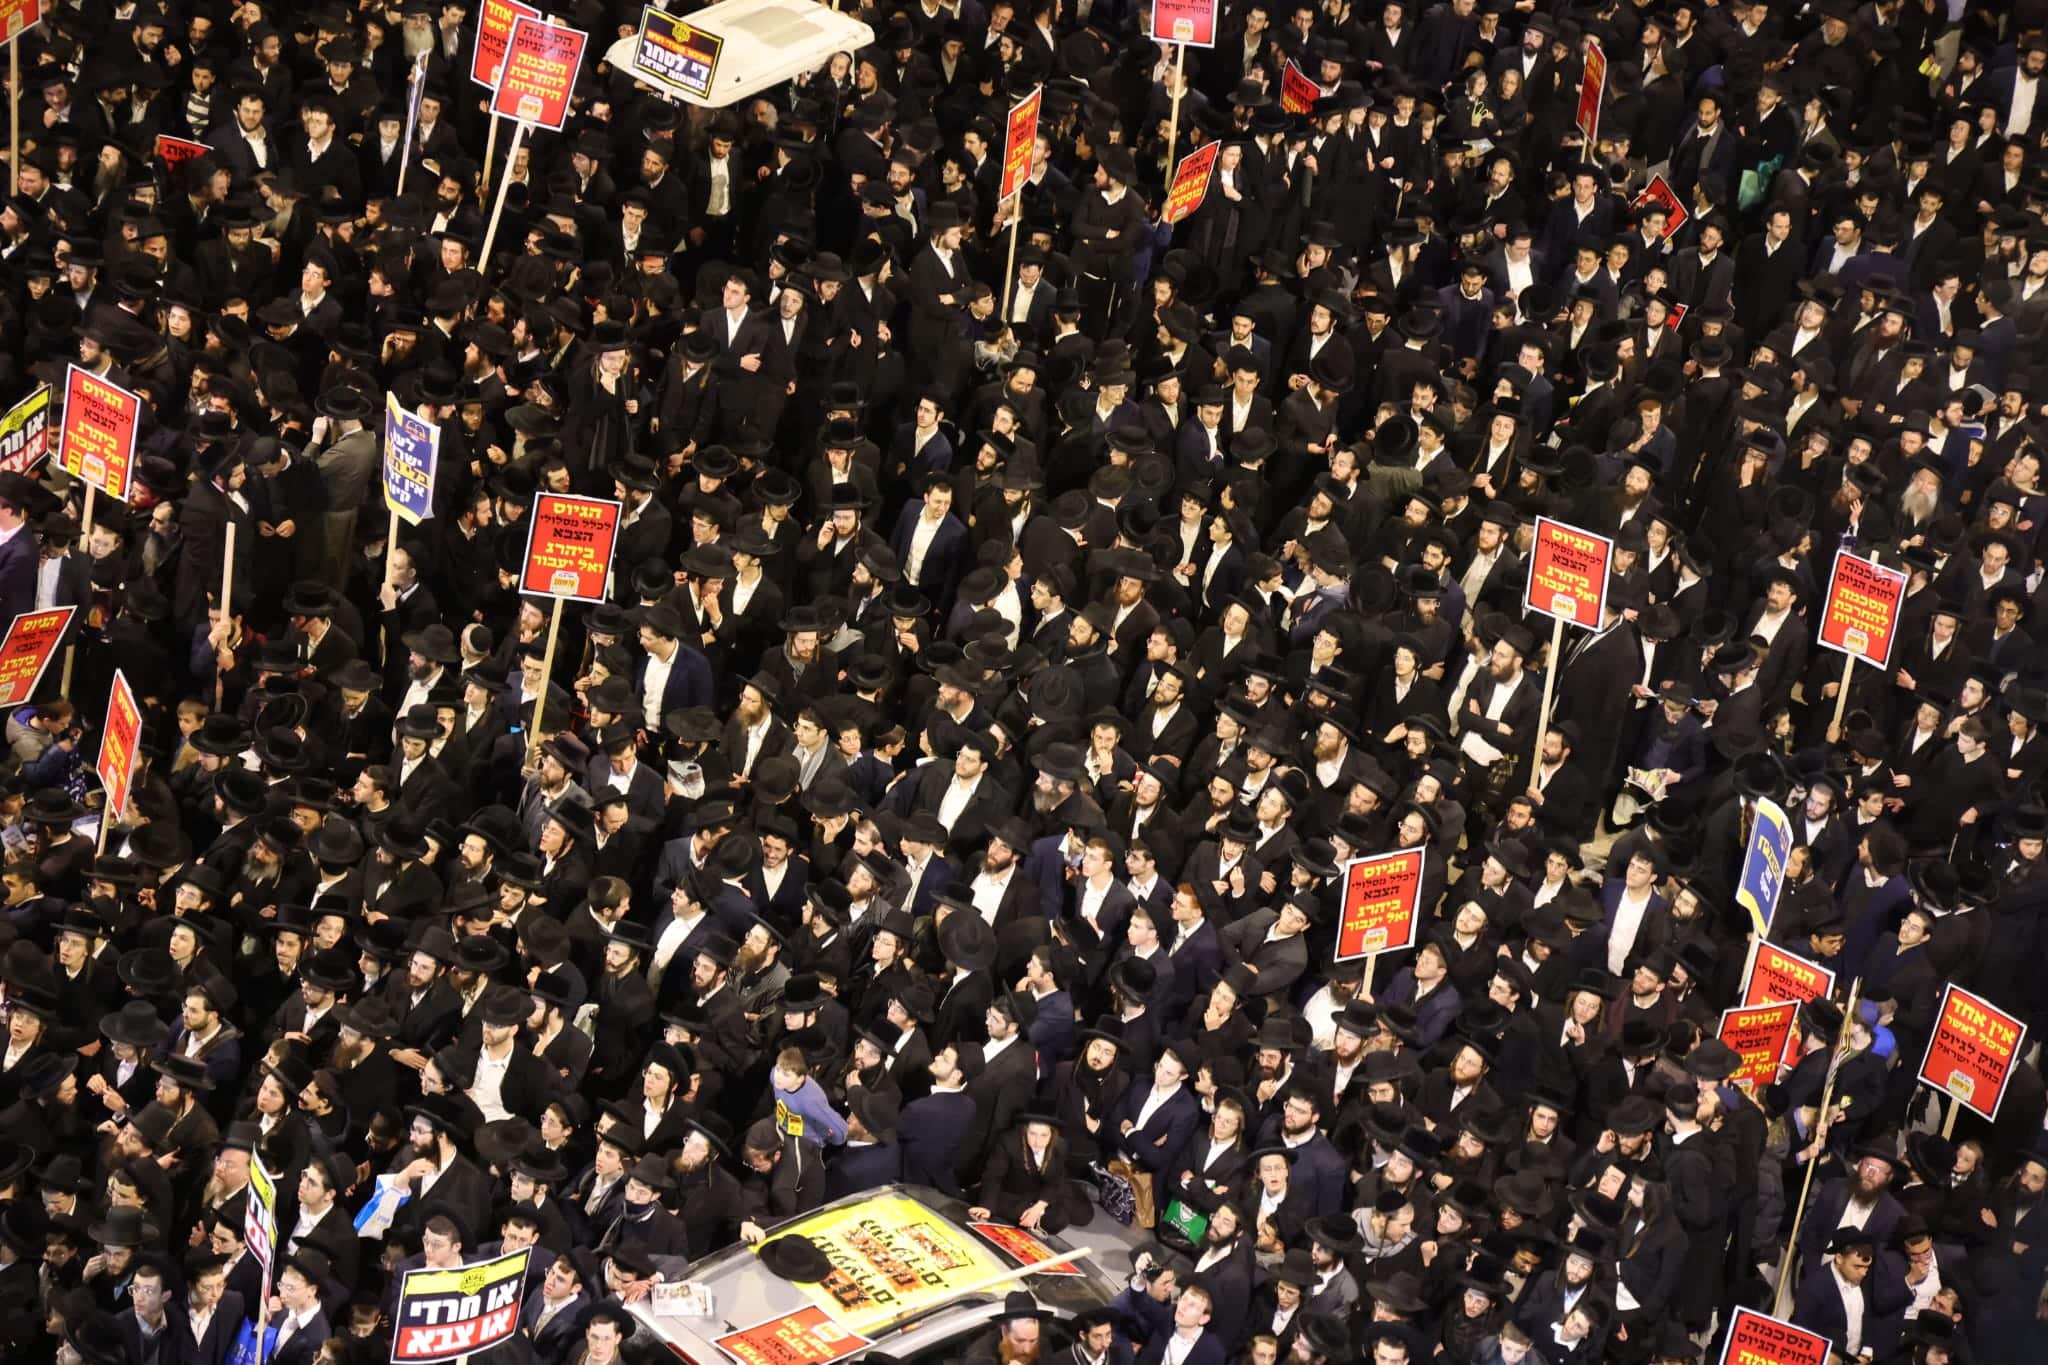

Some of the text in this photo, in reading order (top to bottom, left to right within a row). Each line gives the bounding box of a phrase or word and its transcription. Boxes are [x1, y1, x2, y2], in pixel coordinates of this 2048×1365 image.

[516, 52, 568, 75] הסכמה
[644, 40, 710, 82] די לסחר
[510, 65, 567, 88] להחרבת
[508, 78, 562, 101] היהדות
[82, 380, 123, 409] הגיוס
[84, 407, 117, 432] הצבא
[68, 430, 100, 453] יעבור
[77, 421, 118, 450] ביהרג
[104, 447, 125, 468] ואל
[553, 502, 602, 519] הגיוס
[540, 514, 611, 531] לכלל מסלולי
[553, 527, 594, 542] הצבא
[1552, 529, 1595, 552] הגיוס
[545, 541, 595, 559] ביהרג
[533, 554, 604, 574] ואל יעבור
[1552, 553, 1587, 573] הצבא
[1844, 561, 1892, 587] הסכמה
[1536, 574, 1572, 592] יעבור
[1546, 565, 1590, 589] ביהרג
[1838, 572, 1895, 601] לחוק הגיוס
[1575, 586, 1598, 604] ואל
[1840, 587, 1889, 614] הסכמה
[23, 615, 59, 632] הגיוס
[1834, 598, 1889, 626] להחרבת
[1832, 611, 1885, 638] היהדות
[1352, 872, 1416, 889] לכלל מסלולי
[1364, 860, 1408, 879] הגיוס
[1363, 886, 1400, 900] הצבא
[1357, 899, 1401, 918] ביהרג
[1346, 911, 1409, 931] ואל יעבור
[1758, 965, 1793, 987] מסלולי
[1770, 954, 1816, 986] הגיוס
[1738, 1012, 1782, 1028] הגיוס
[1952, 996, 2016, 1044] אין אחד
[1734, 1037, 1771, 1050] הצבא
[1946, 1014, 2009, 1056] שיכול לאשר
[1937, 1040, 1969, 1064] ישראל
[1940, 1029, 2004, 1073] חוק לגיוס
[1972, 1063, 1999, 1084] בחורי
[486, 1279, 518, 1313] או
[410, 1295, 481, 1325] חרדי
[406, 1308, 512, 1354] או צבא
[1745, 1320, 1813, 1350] הסכמה
[1738, 1332, 1818, 1365] לחוק הגיוס
